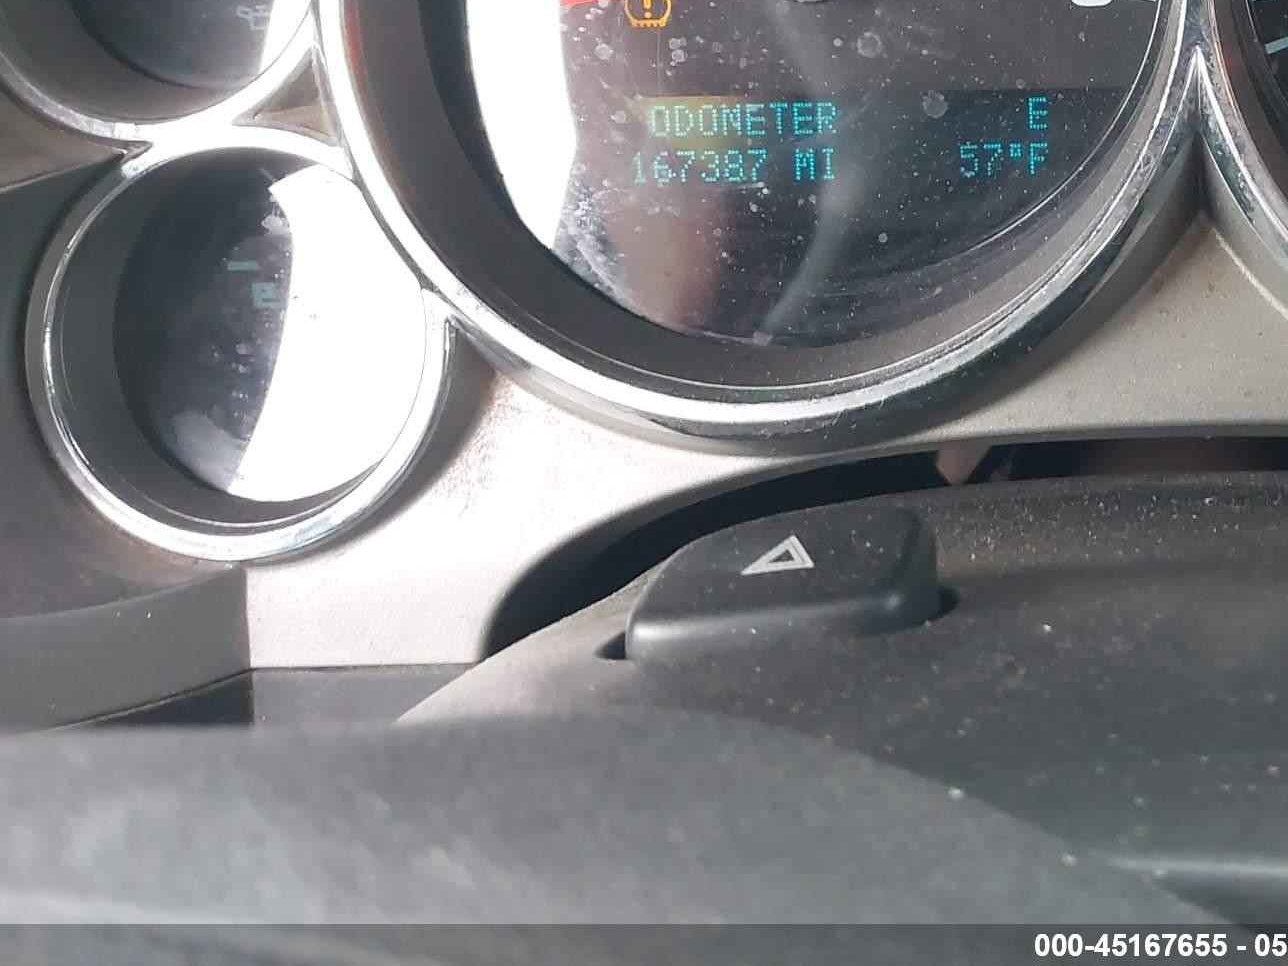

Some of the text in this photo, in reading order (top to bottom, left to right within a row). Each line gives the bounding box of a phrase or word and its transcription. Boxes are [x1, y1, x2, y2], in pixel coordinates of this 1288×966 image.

[651, 102, 838, 136] ODOMETER
[1028, 96, 1049, 131] E
[632, 147, 836, 184] 167387 MI
